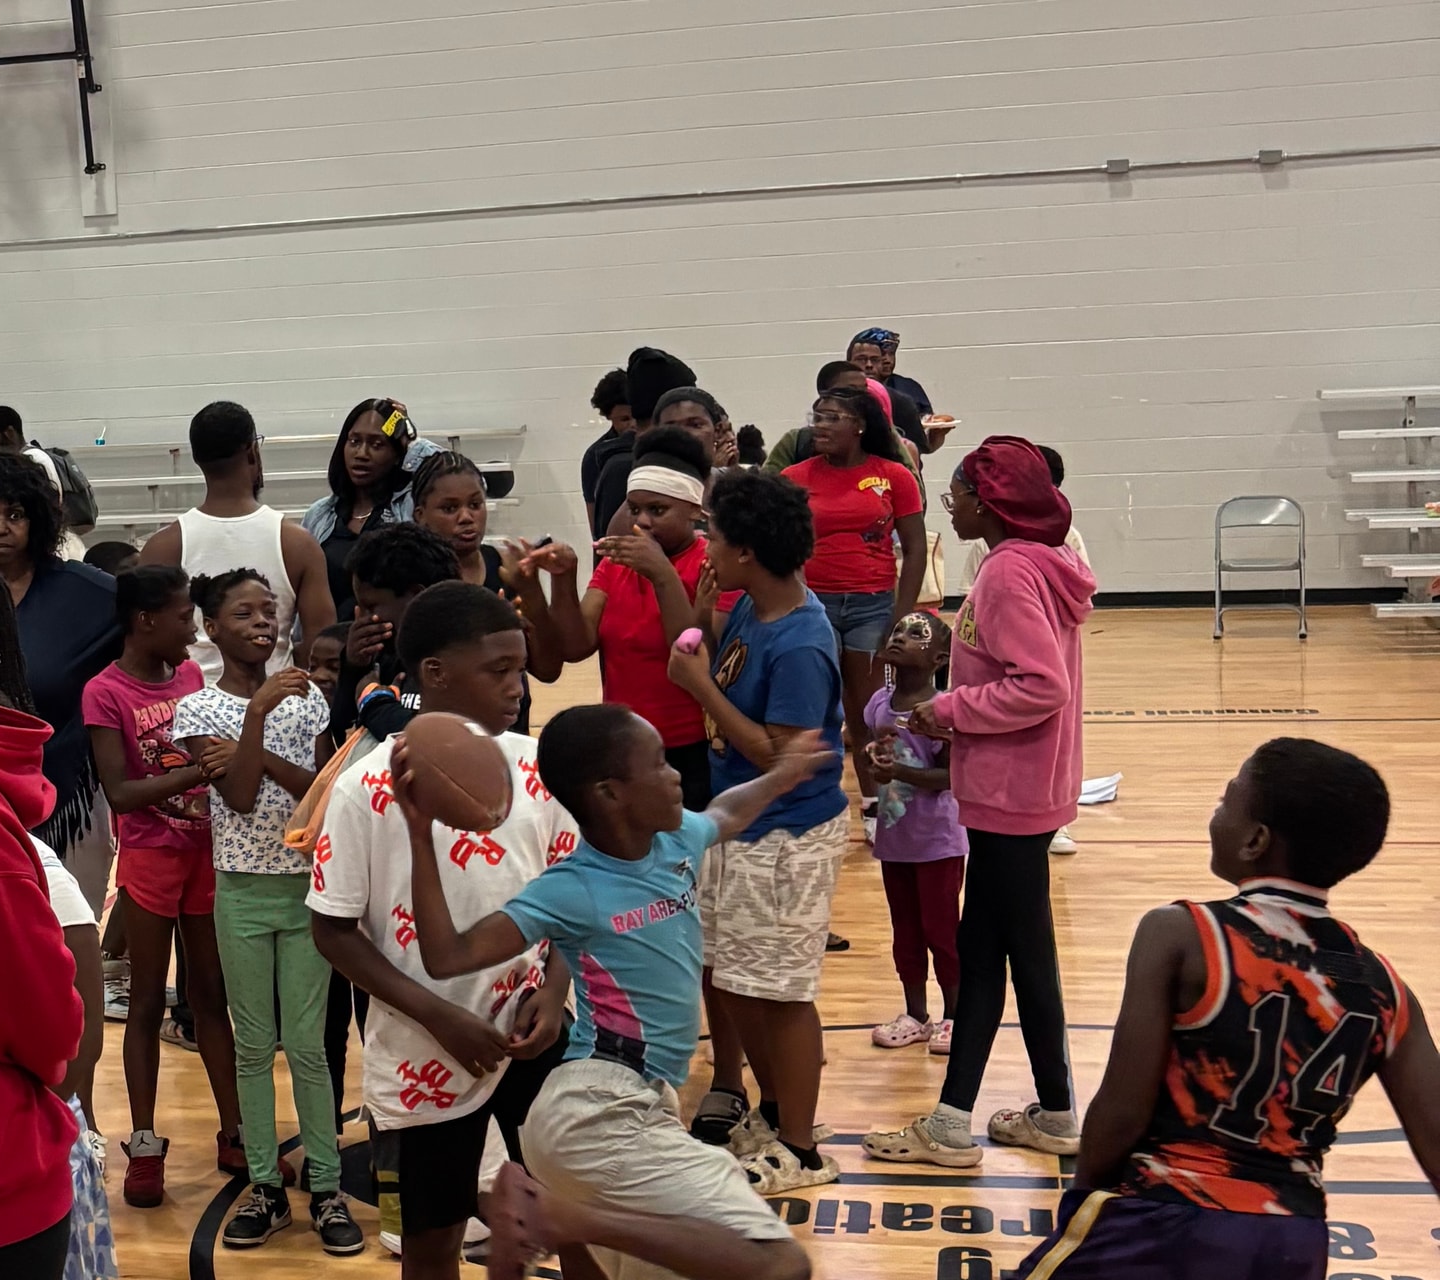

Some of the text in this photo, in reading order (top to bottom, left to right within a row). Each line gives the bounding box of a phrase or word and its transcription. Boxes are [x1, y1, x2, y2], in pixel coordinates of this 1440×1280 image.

[611, 907, 645, 935] BAY
[1209, 991, 1378, 1144] 14
[763, 1196, 1055, 1237] reatio
